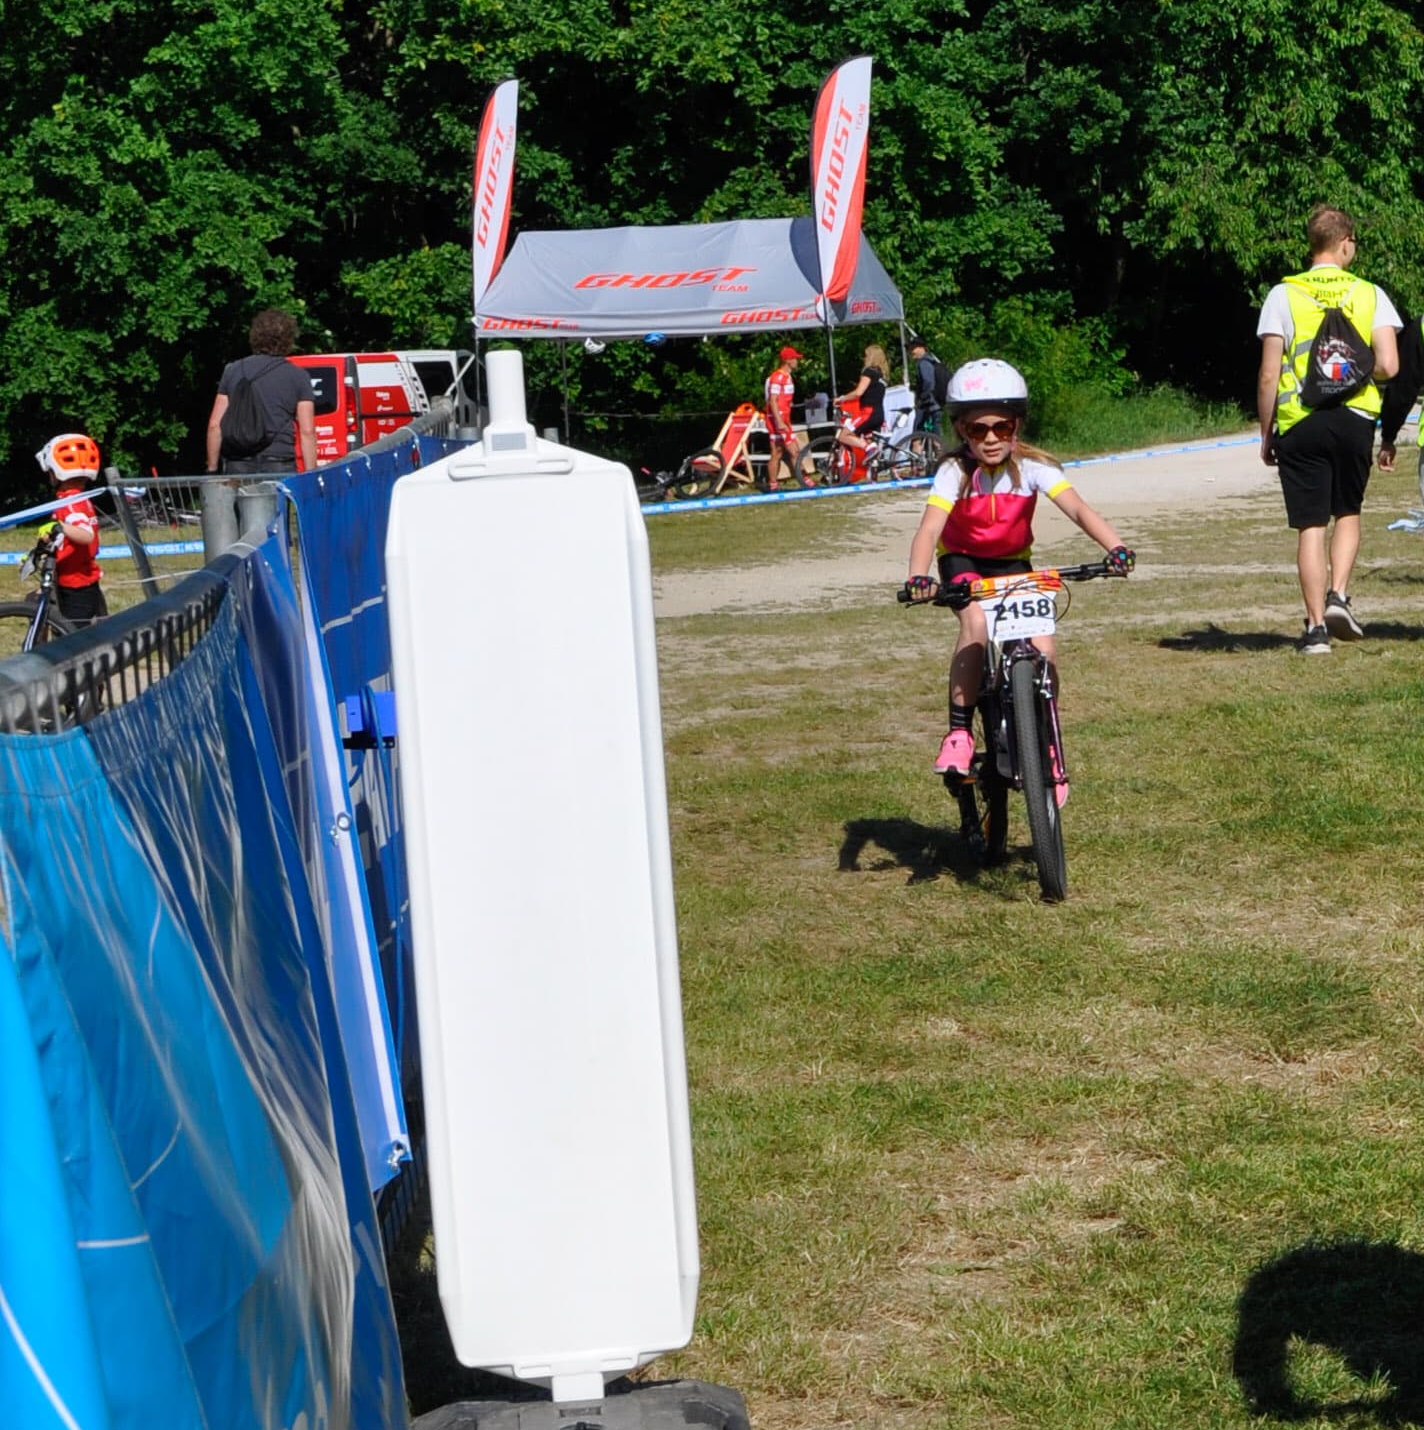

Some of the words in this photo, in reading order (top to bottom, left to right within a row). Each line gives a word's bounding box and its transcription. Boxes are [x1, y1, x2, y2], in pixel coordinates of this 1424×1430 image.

[820, 98, 854, 234] GHOST
[476, 125, 506, 249] GHOST
[574, 267, 758, 289] GHOST
[482, 317, 566, 331] GHOST
[720, 308, 806, 325] GHOST
[993, 598, 1050, 622] 2158
